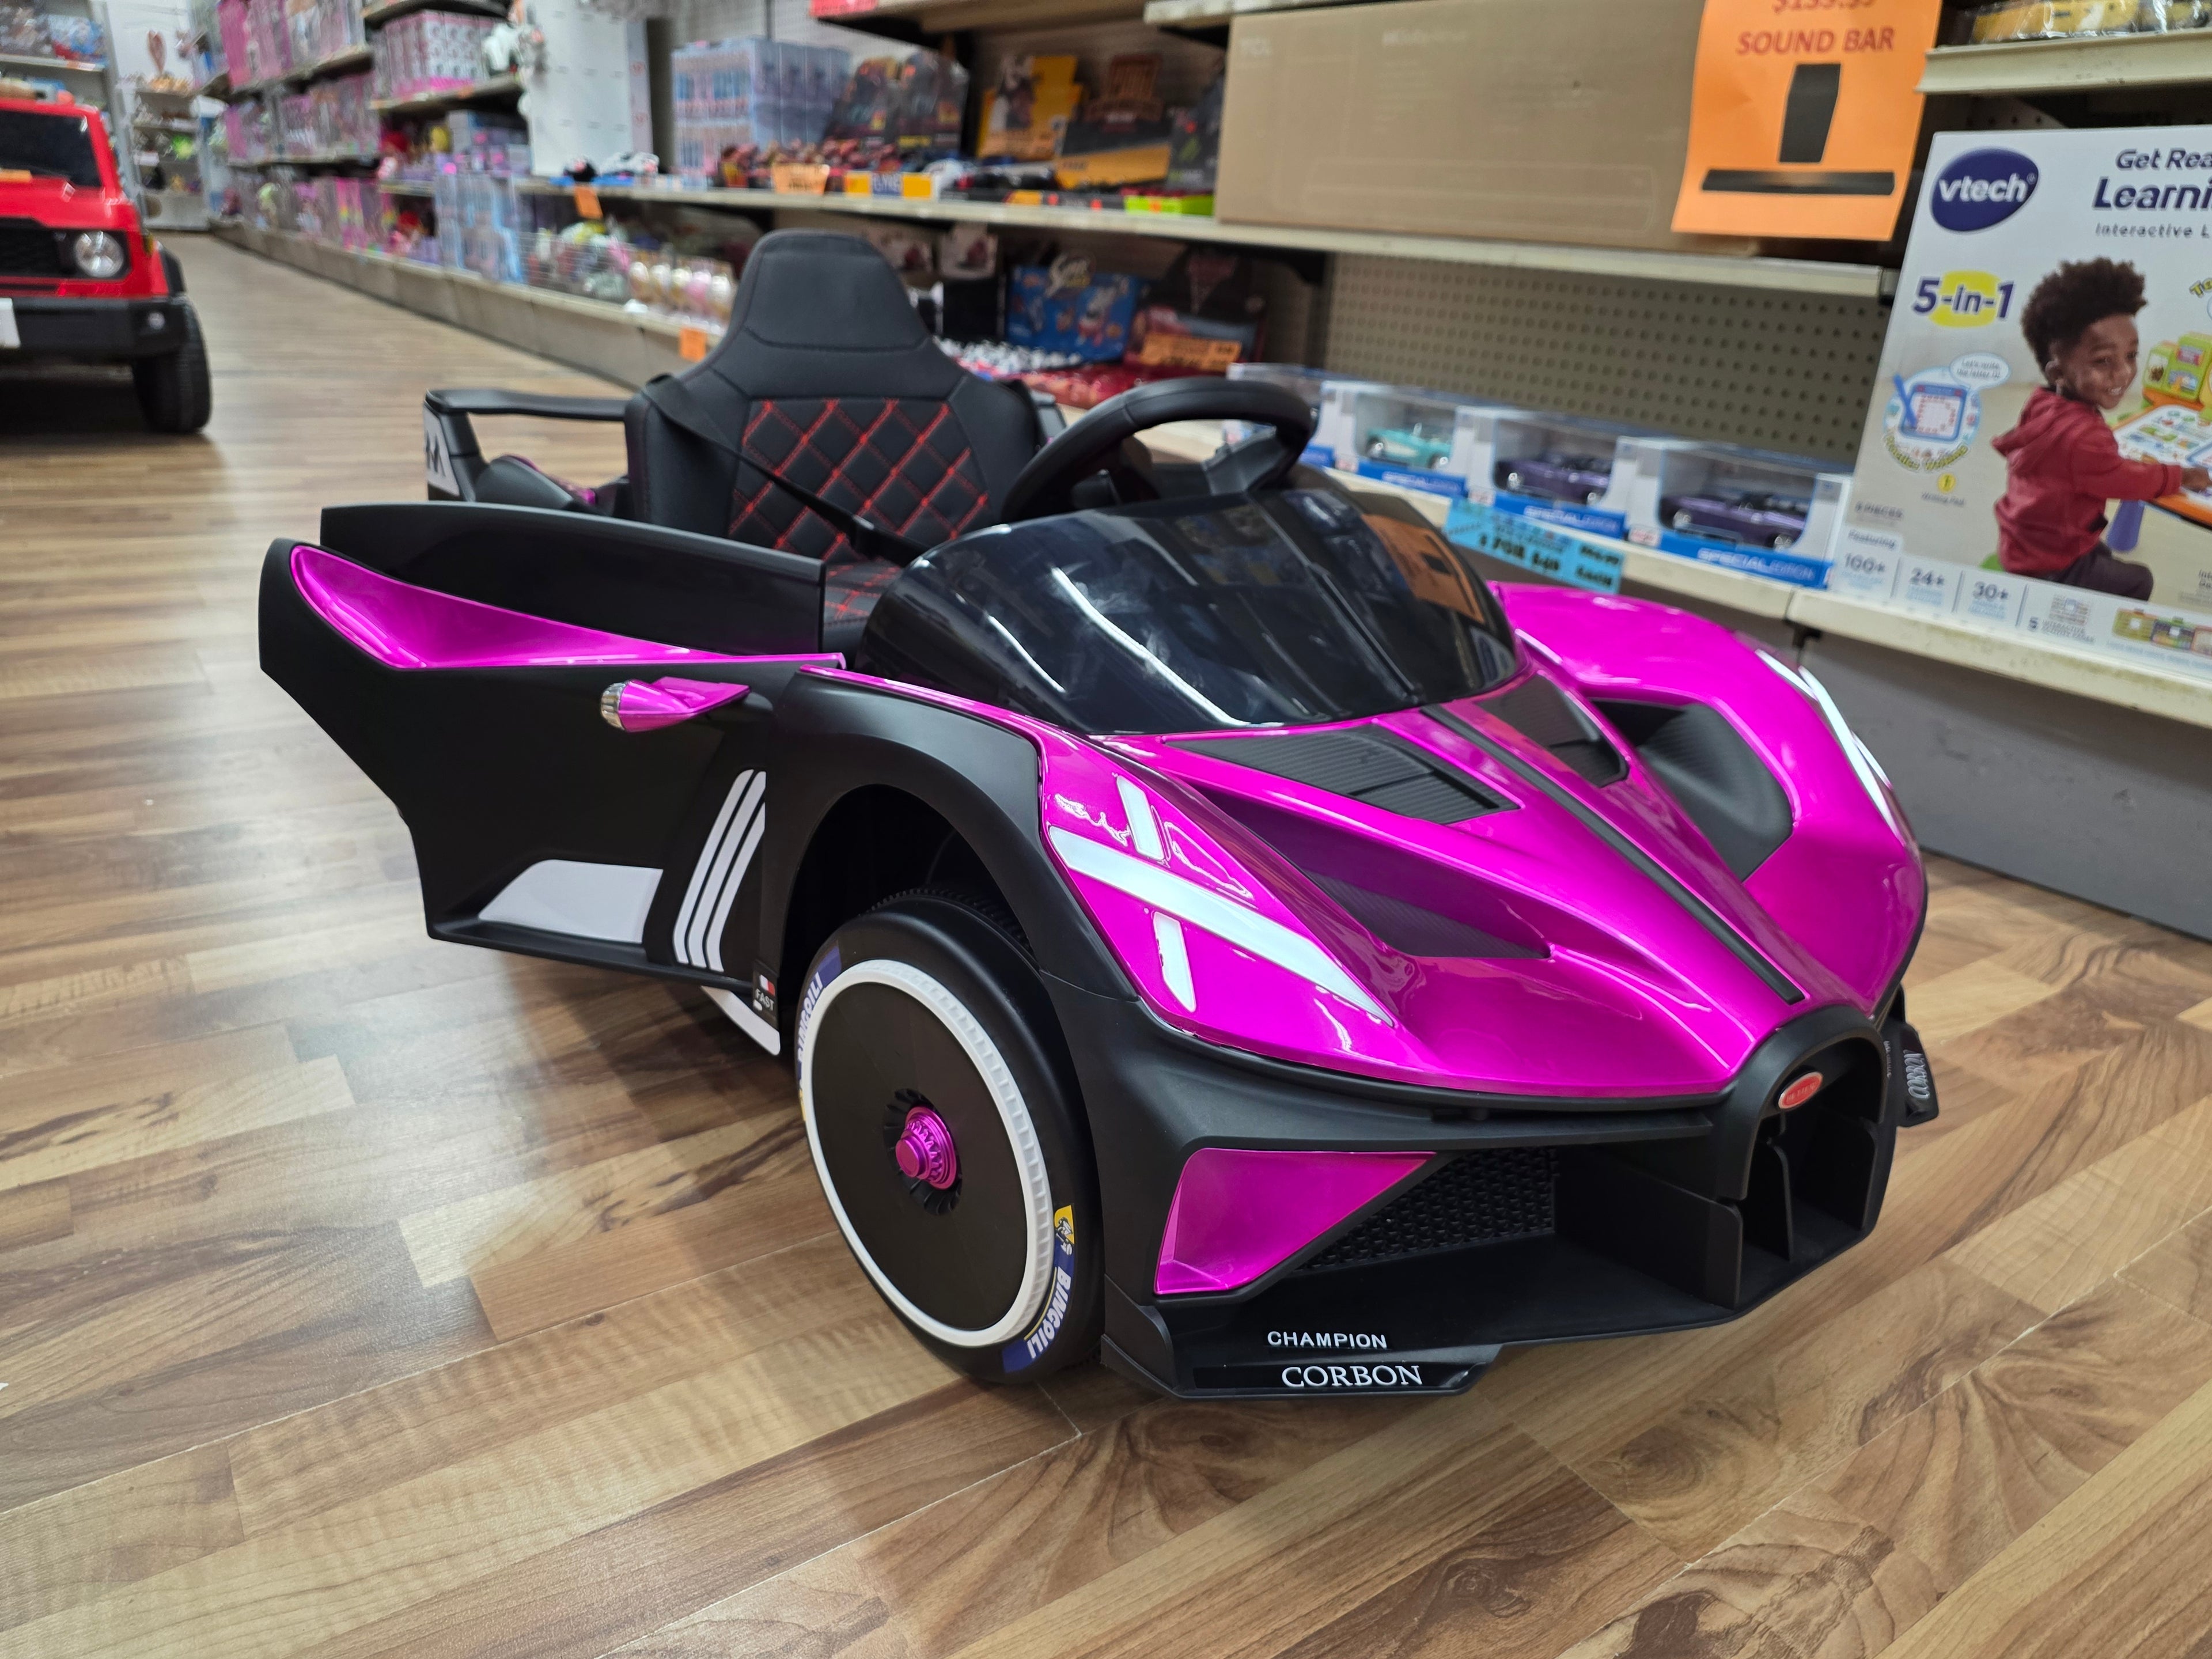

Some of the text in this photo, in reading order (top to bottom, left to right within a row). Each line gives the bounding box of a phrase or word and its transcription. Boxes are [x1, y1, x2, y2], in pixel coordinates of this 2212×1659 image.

[1737, 27, 1894, 55] SOUND BAR
[2115, 148, 2161, 171] Get
[1938, 173, 2029, 202] vtech
[2095, 222, 2193, 238] Interactive
[1912, 275, 2015, 320] 5-in-1
[1697, 548, 1770, 571] SPECIAL
[755, 987, 775, 1012] FAST
[1267, 1330, 1388, 1349] CHAMPION
[1281, 1365, 1424, 1389] CORBON
